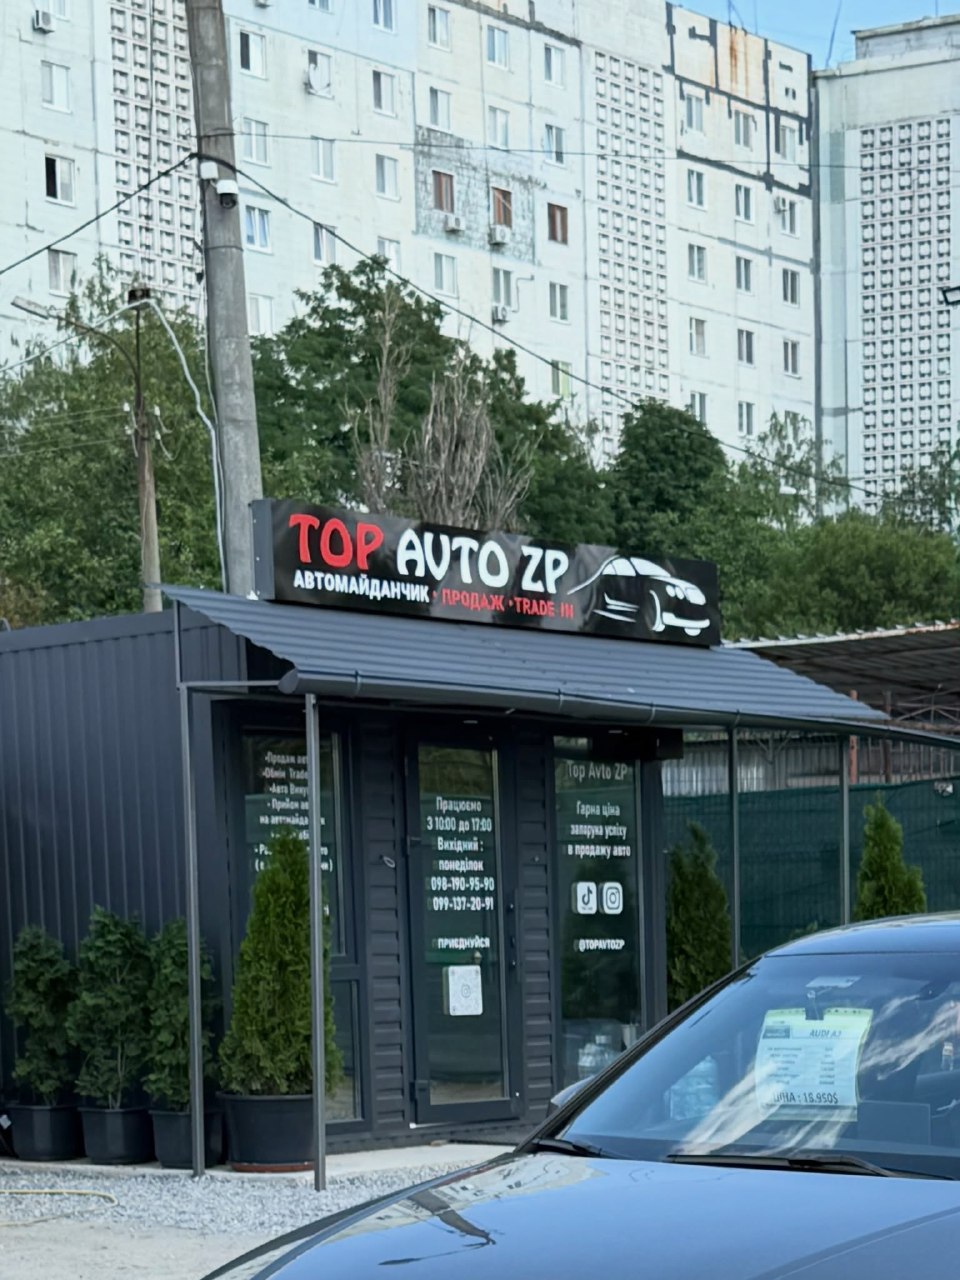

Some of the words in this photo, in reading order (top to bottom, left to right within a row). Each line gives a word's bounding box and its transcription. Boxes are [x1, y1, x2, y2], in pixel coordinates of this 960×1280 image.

[288, 512, 385, 572] TOP
[520, 544, 569, 595] ZP
[293, 568, 430, 604] АВТОМАЙДАНЧИК
[441, 588, 506, 614] ПРОДАЖ
[514, 597, 555, 617] TRADE
[567, 760, 585, 782] Top
[588, 761, 611, 780] Avto
[614, 763, 628, 780] ZP
[436, 796, 482, 814] Працюємо
[576, 801, 600, 818] Гарна
[602, 802, 621, 818] ціна
[435, 816, 456, 831] 10:00
[458, 819, 470, 833] до
[472, 817, 492, 832] 17:00
[570, 823, 604, 838] запорука
[605, 823, 627, 840] успіху
[437, 836, 479, 851] Вихідний
[575, 844, 611, 859] продажу
[613, 845, 631, 857] авто
[438, 857, 484, 873] понеділок
[431, 876, 495, 891] 098-190-95-90
[432, 896, 494, 911] 099-137-20-91
